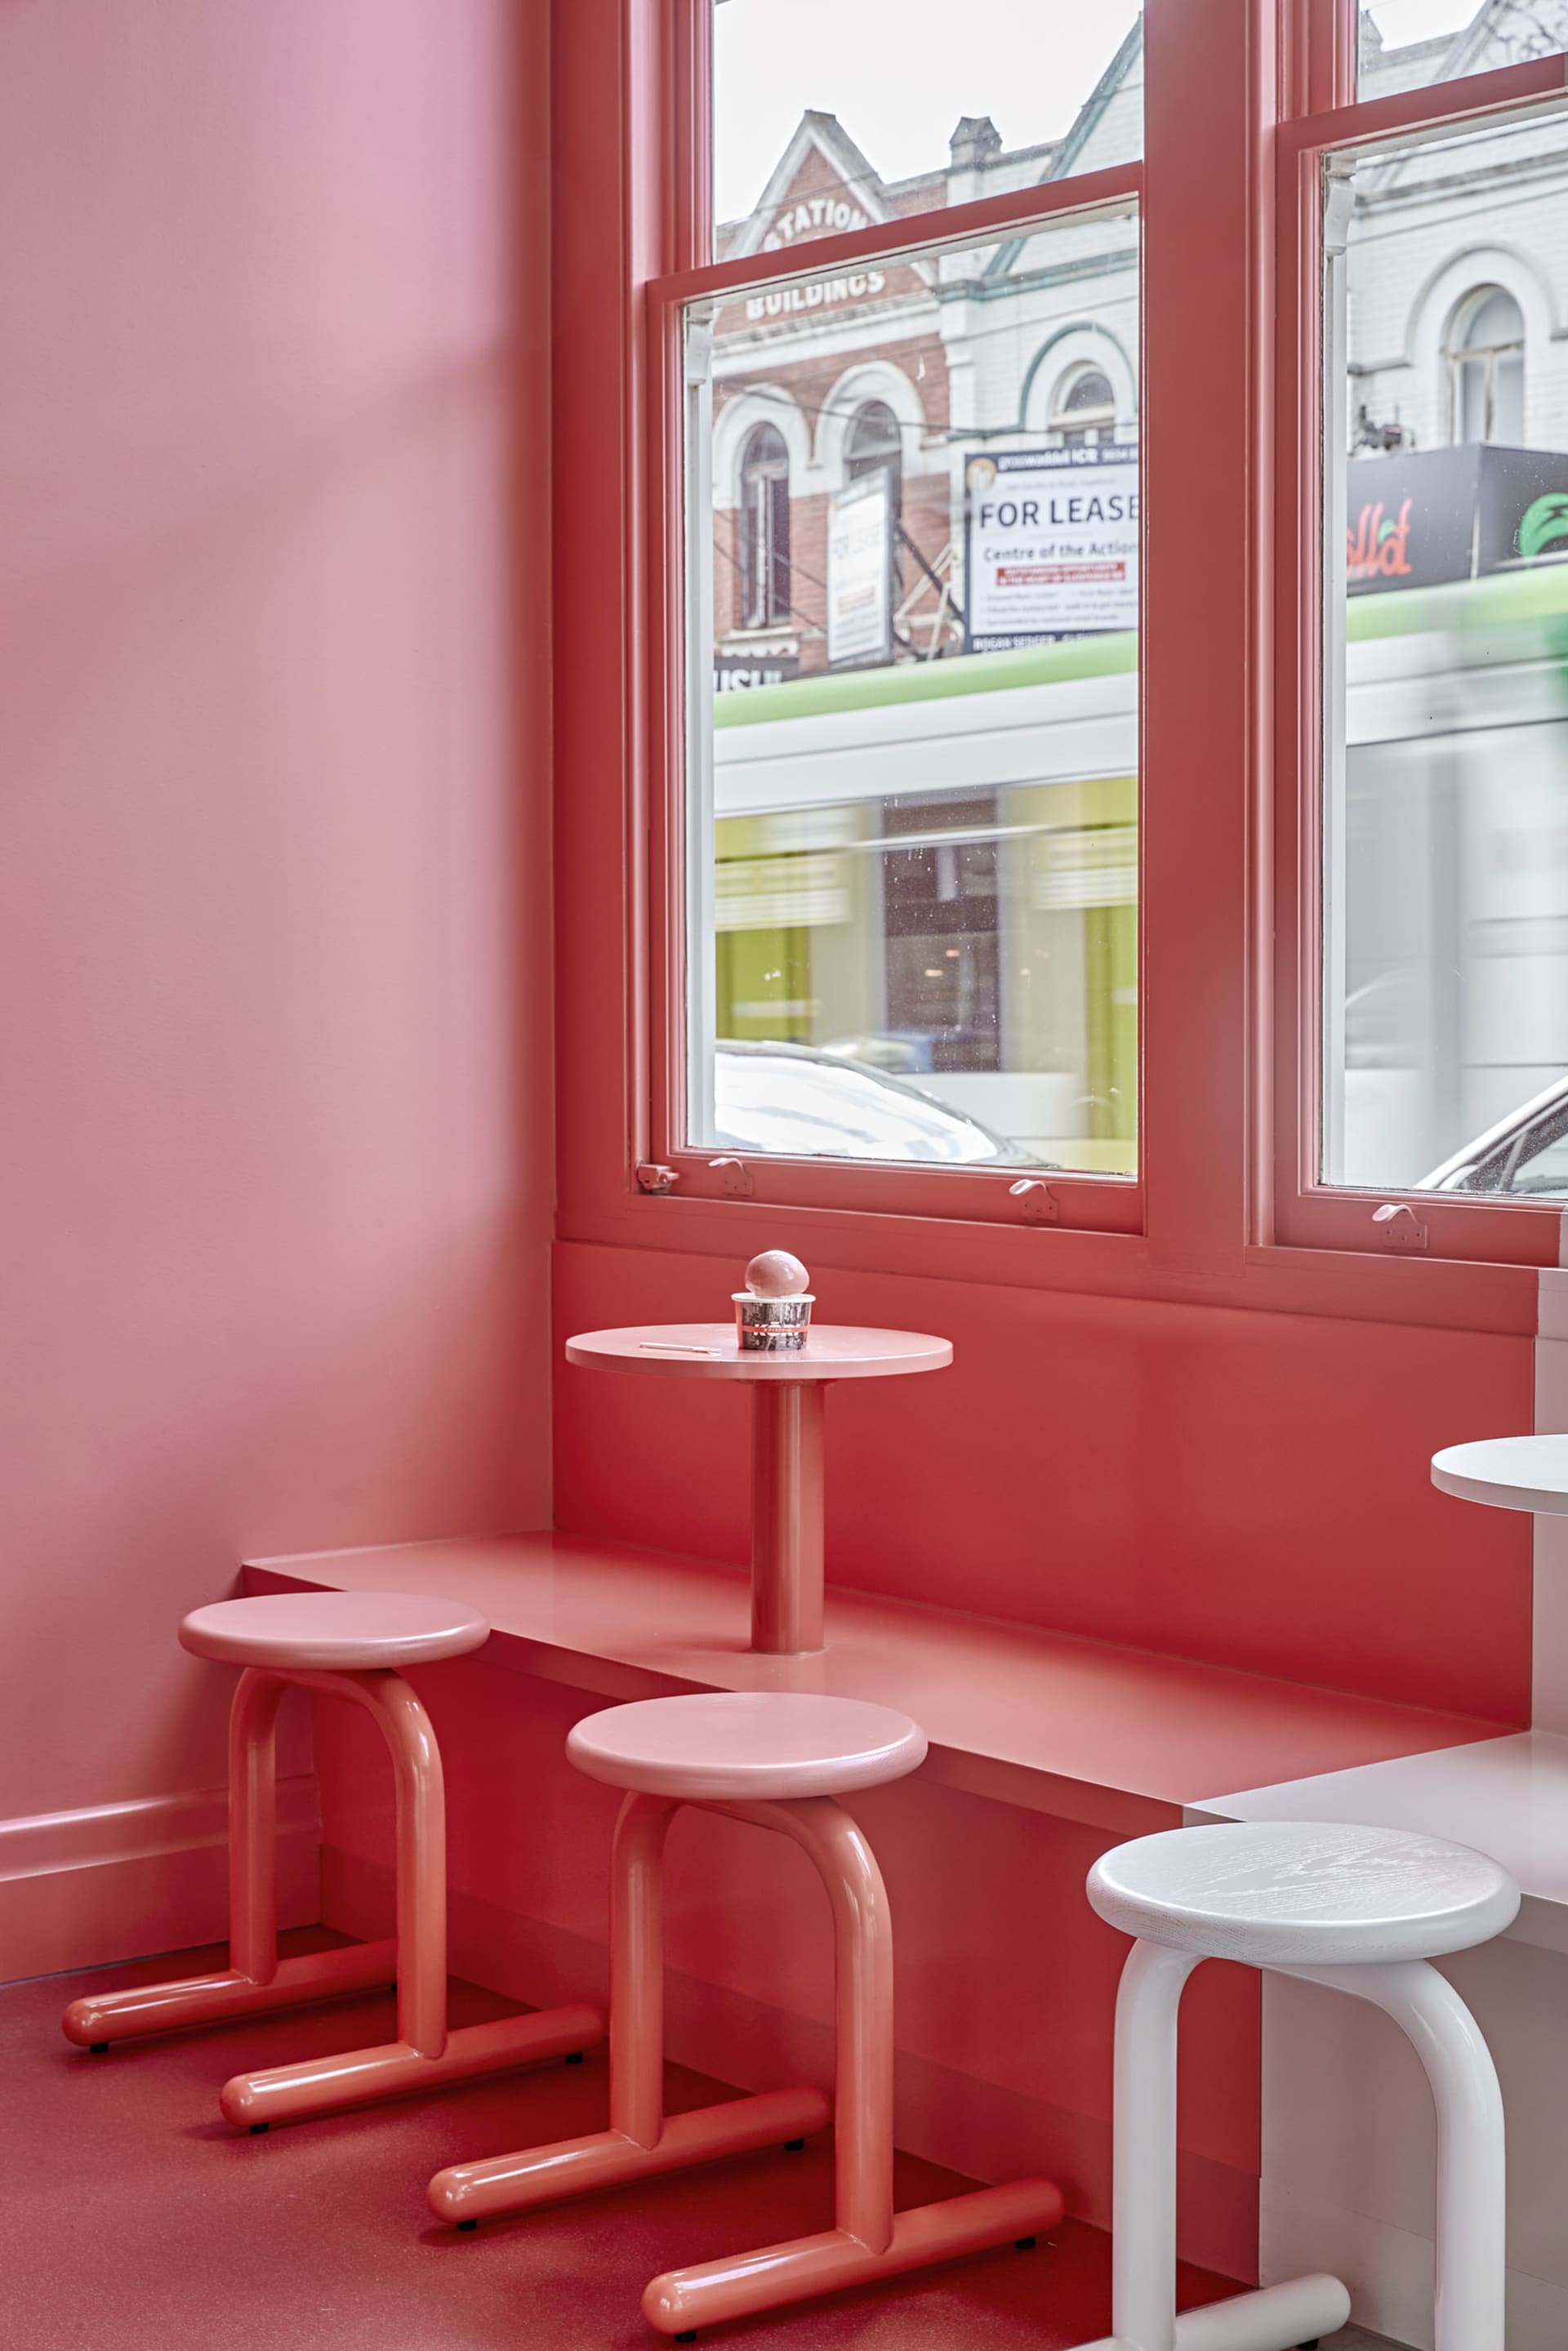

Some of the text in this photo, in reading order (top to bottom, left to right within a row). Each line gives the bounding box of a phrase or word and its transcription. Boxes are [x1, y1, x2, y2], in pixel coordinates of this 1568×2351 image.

[764, 199, 867, 251] STATION
[746, 271, 885, 320] BUILDINGS
[979, 495, 1138, 529] FOR LEASE
[984, 545, 1034, 562] Centre
[1039, 545, 1055, 559] of
[1059, 542, 1084, 558] the
